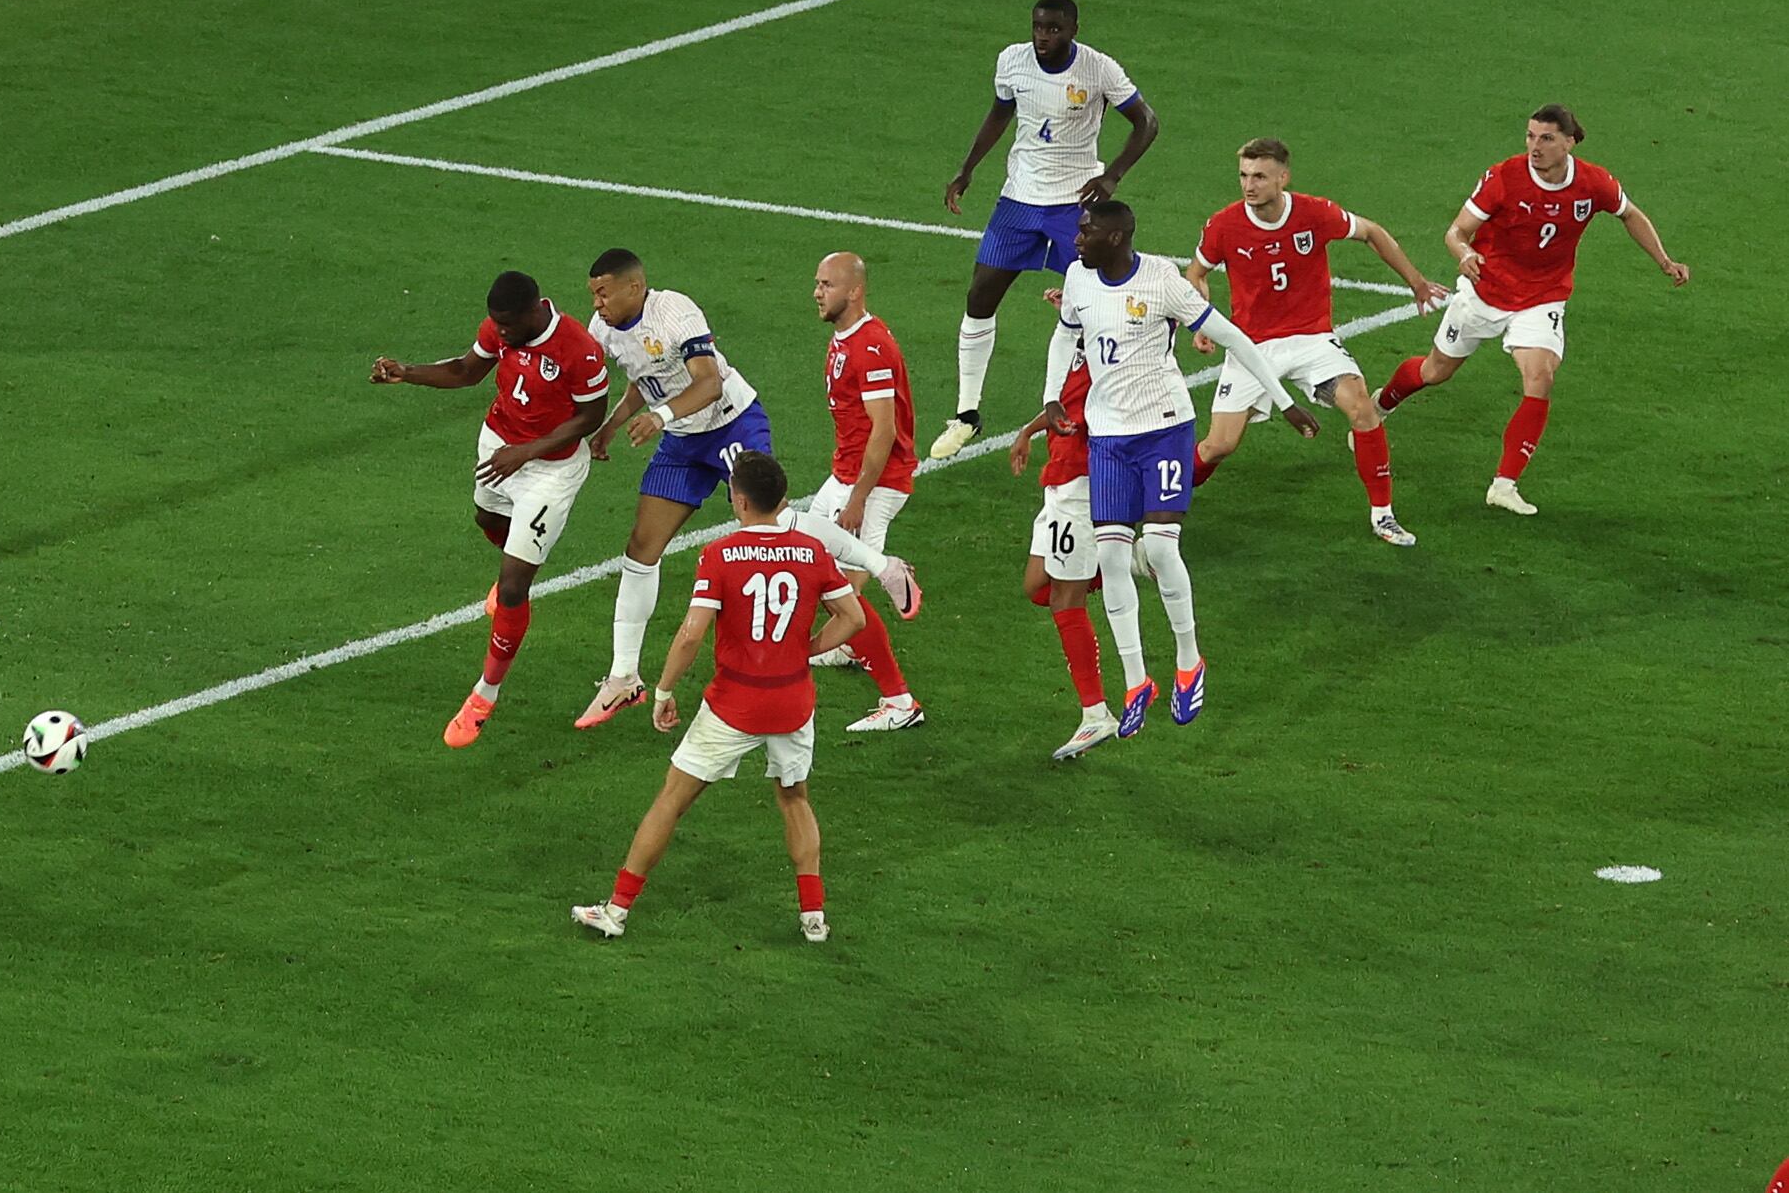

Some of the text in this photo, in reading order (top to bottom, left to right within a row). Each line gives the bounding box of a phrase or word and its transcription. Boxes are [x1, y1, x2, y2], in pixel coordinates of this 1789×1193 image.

[1038, 118, 1053, 144] 4
[1539, 222, 1558, 249] 9
[1270, 262, 1288, 291] 5
[1097, 336, 1119, 366] 12
[512, 374, 529, 405] 4
[637, 375, 667, 400] 10
[1157, 459, 1183, 492] 12
[528, 505, 549, 538] 4
[1048, 519, 1076, 555] 16
[721, 545, 815, 565] BAUMGARTNER
[741, 570, 800, 643] 19
